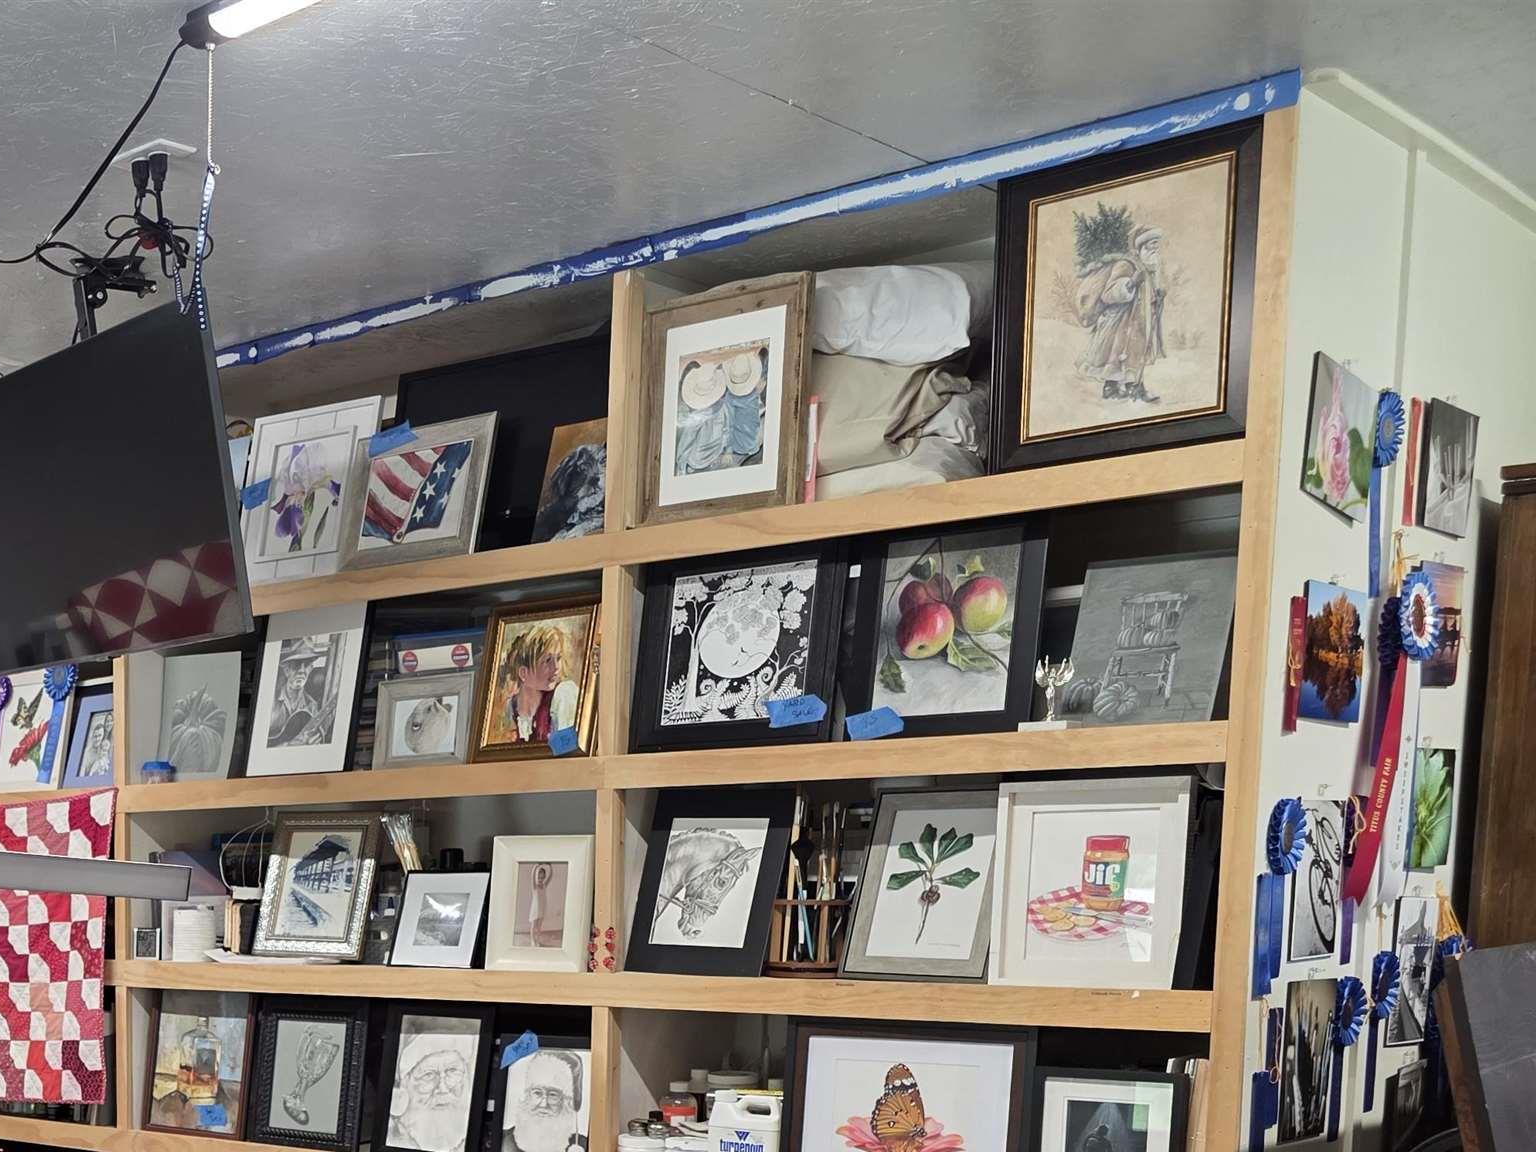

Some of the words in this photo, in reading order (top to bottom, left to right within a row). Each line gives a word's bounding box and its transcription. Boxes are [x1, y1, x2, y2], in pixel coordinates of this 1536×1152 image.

[1369, 811, 1380, 833] TITUS
[1375, 777, 1388, 809] COUNTY
[1383, 757, 1393, 776] FAIR
[1084, 863, 1121, 885] Jif
